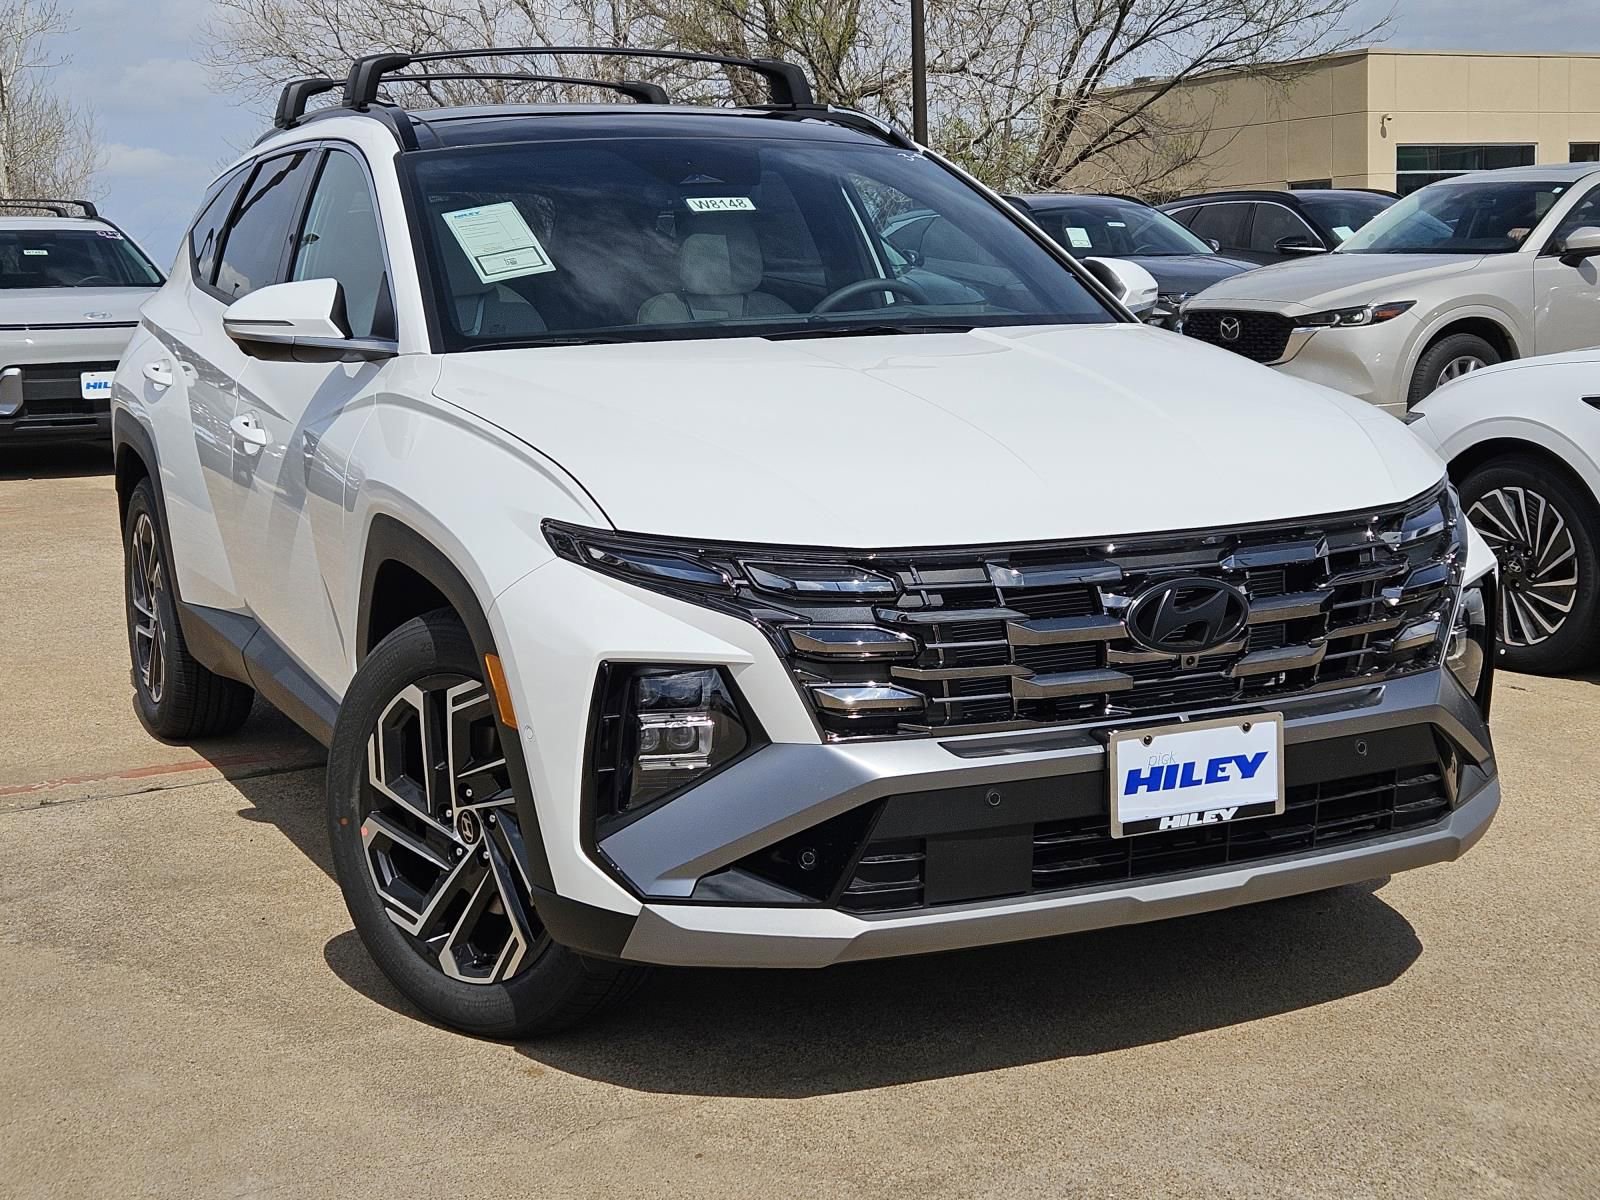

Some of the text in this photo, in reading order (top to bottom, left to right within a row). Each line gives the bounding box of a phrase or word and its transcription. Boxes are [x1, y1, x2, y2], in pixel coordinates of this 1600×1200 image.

[691, 198, 748, 210] W8148
[85, 381, 113, 390] HIL
[1123, 751, 1269, 796] HILEY
[1159, 806, 1239, 831] HILEY
